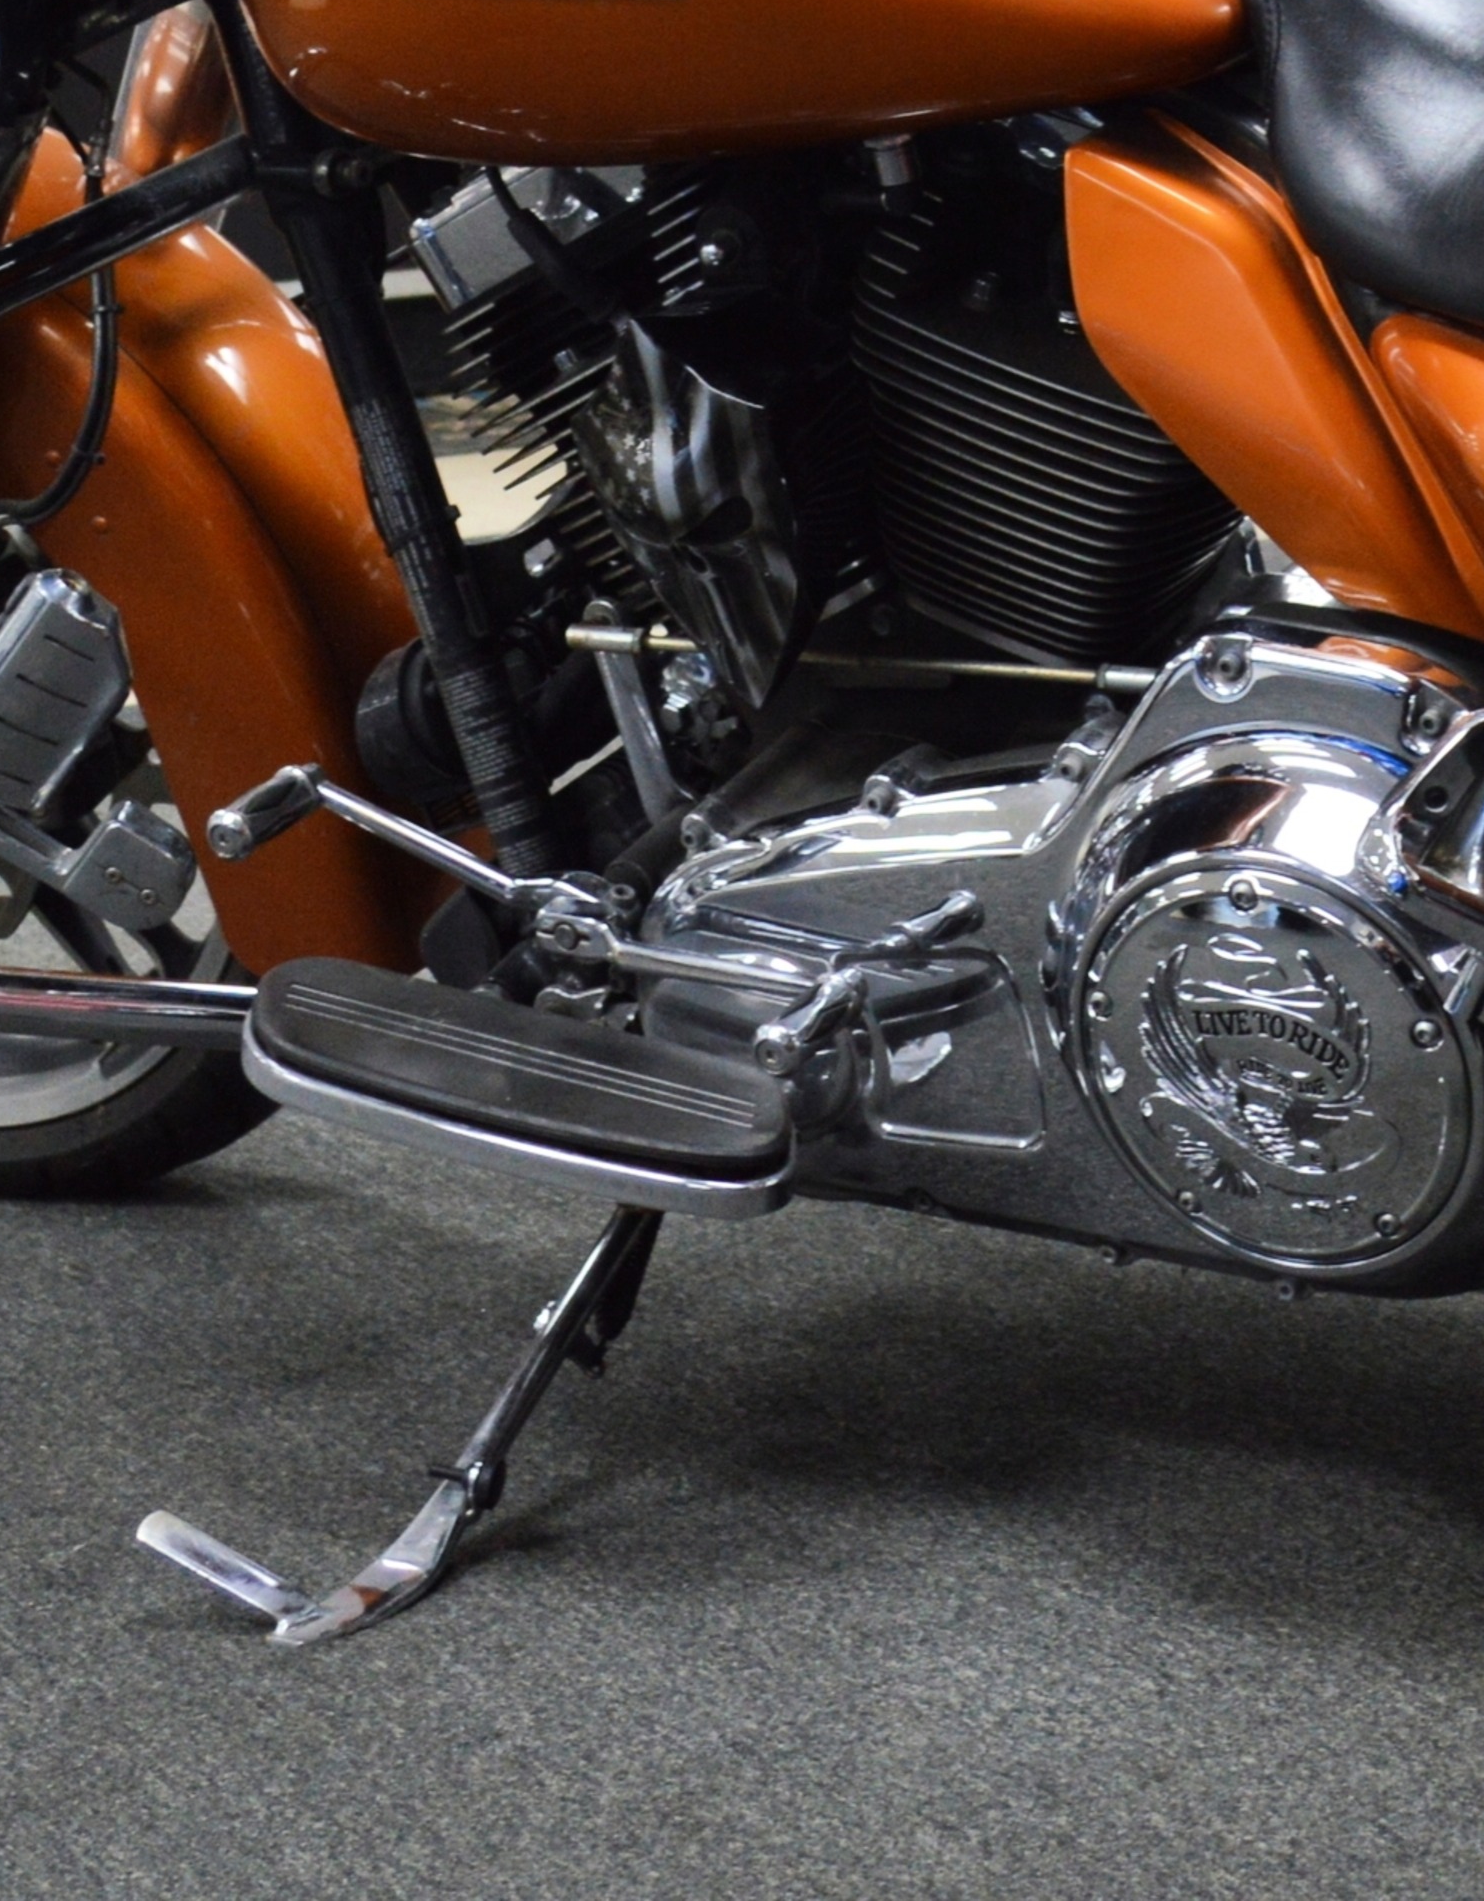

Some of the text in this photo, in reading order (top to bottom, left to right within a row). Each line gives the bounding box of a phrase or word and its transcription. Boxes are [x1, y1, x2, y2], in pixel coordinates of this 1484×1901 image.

[1193, 1009, 1351, 1080] LIVE TO RIDE
[1298, 1079, 1329, 1096] LIVE
